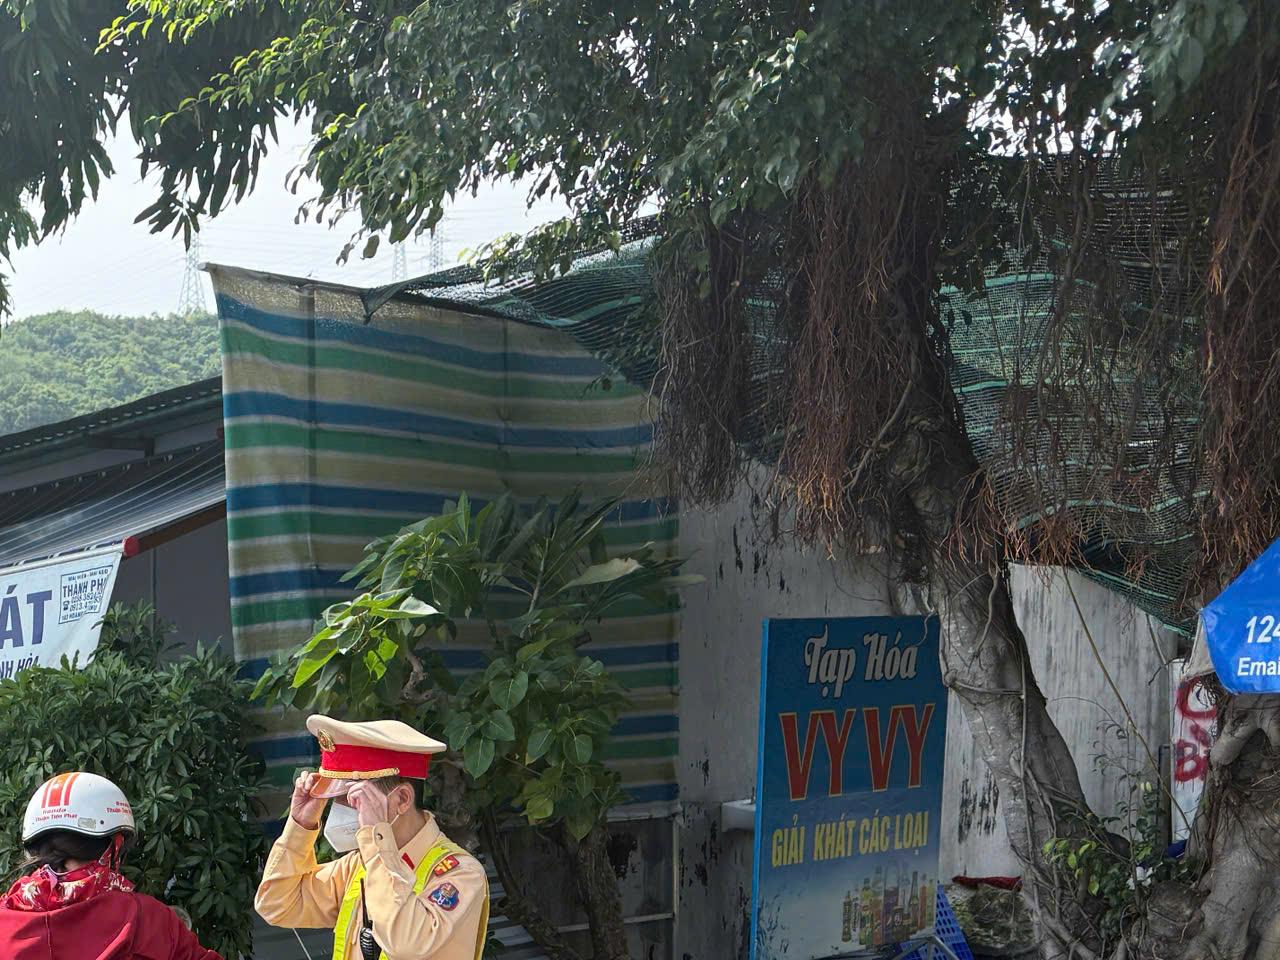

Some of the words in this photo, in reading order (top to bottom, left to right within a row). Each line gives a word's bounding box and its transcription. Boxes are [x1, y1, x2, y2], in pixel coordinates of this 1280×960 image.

[804, 624, 857, 698] Tạp
[863, 631, 919, 681] Hóa
[778, 707, 857, 801] VY
[862, 703, 936, 793] VY
[771, 814, 806, 868] GIẢI
[813, 812, 857, 861] KHÁT
[858, 809, 891, 855] CÁC
[893, 811, 929, 856] LOẠI
